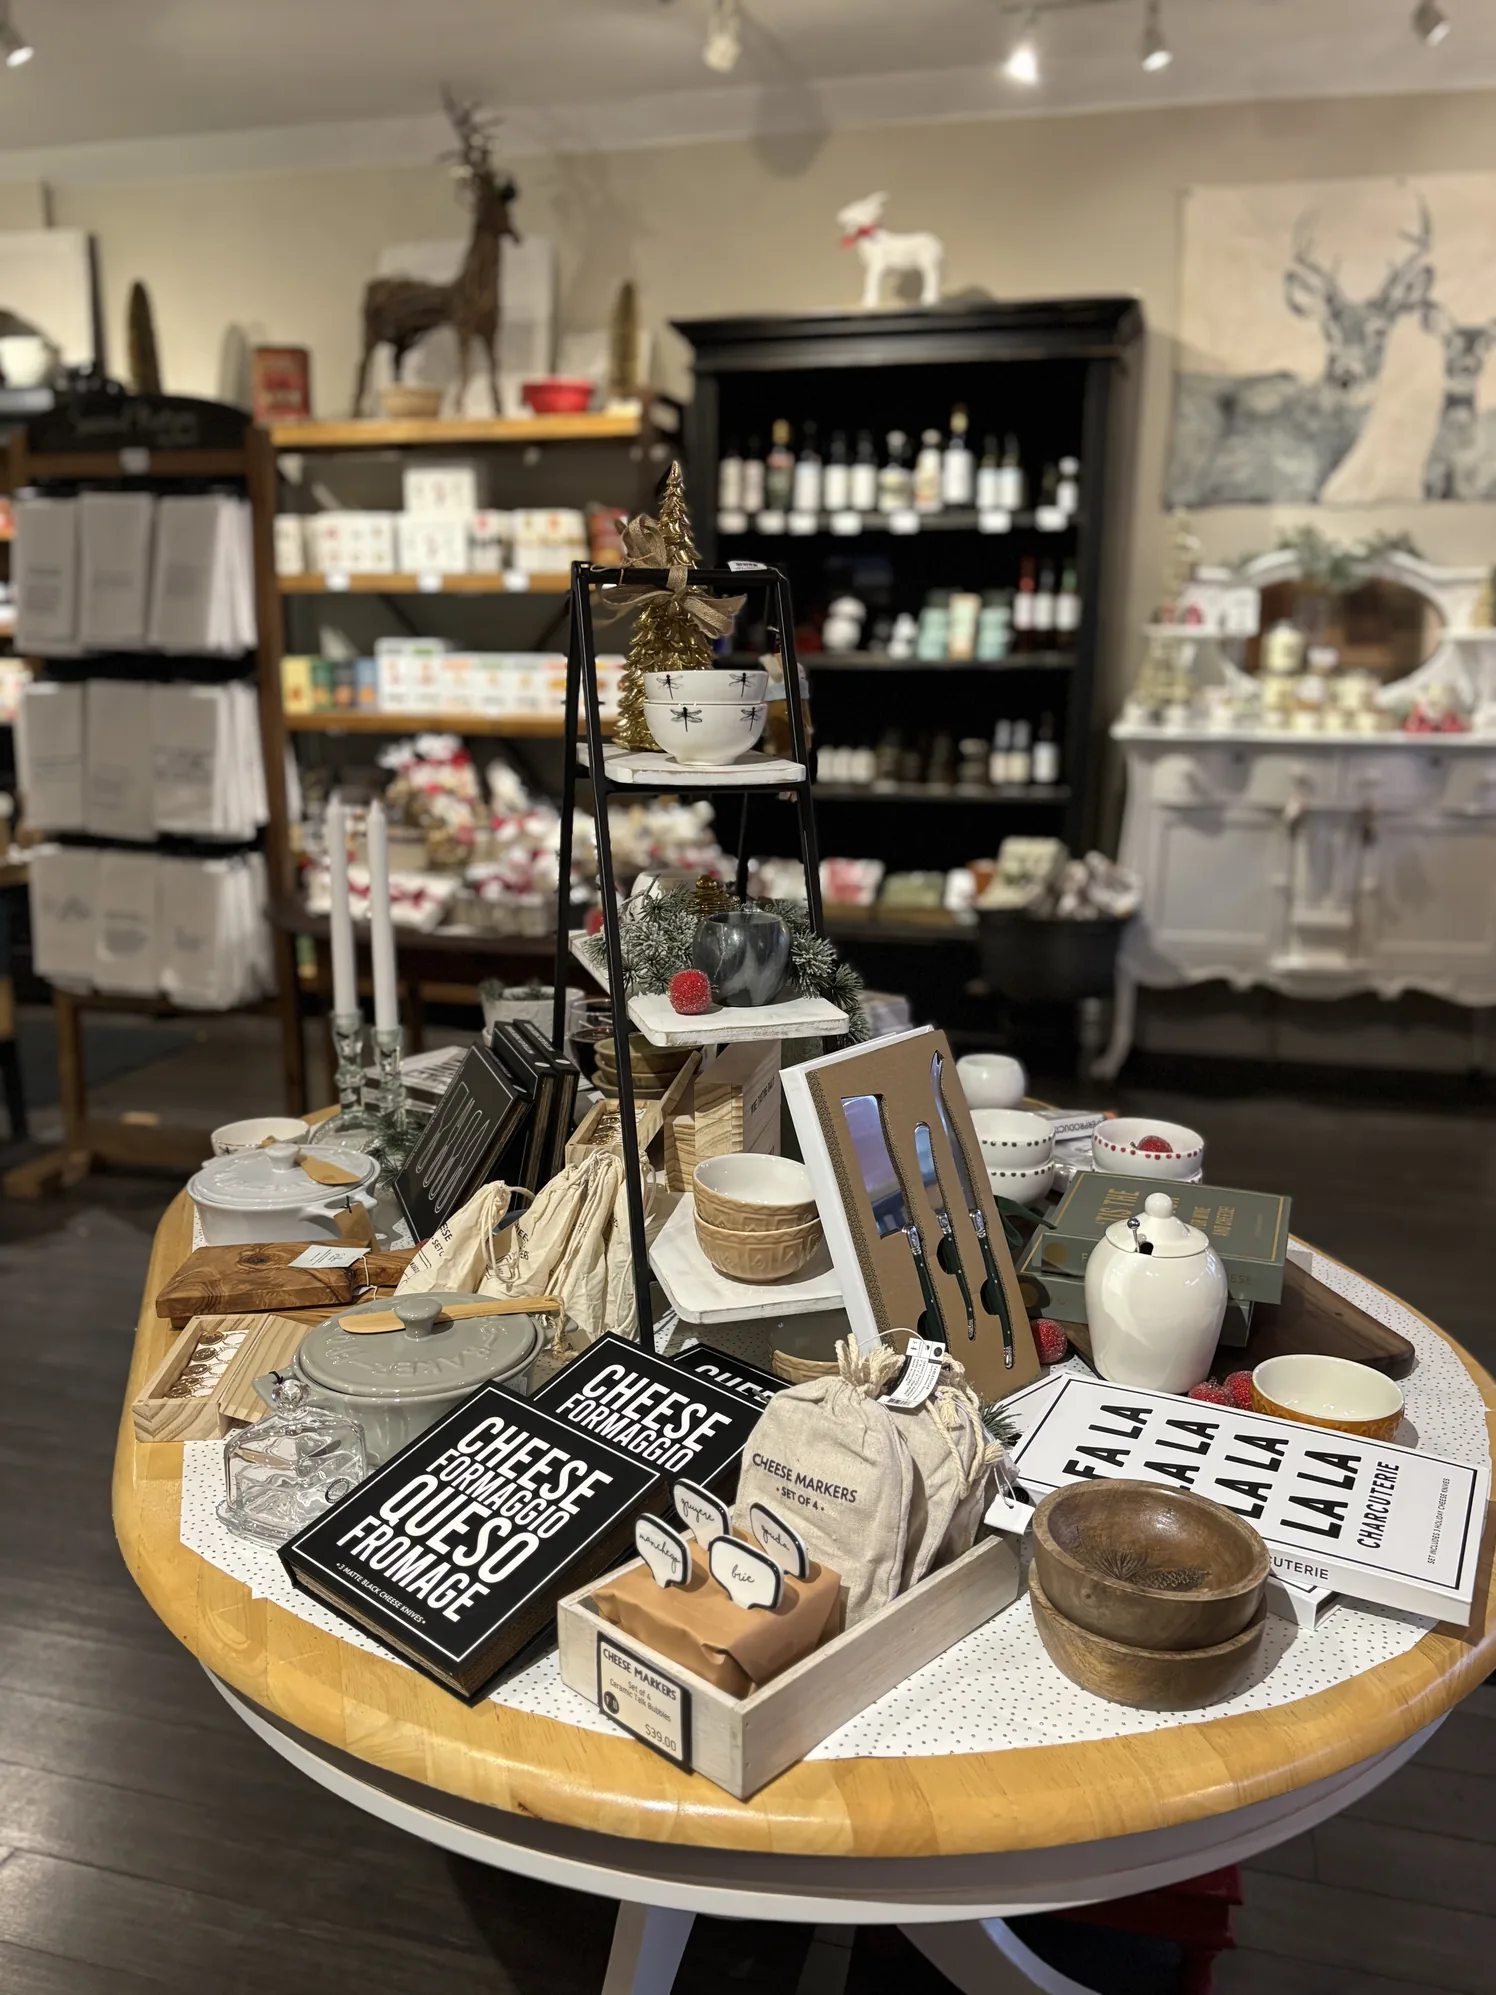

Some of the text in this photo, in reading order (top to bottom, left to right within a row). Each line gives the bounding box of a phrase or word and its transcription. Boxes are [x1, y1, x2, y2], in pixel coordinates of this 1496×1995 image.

[555, 1392, 694, 1473] FORMAGGIO
[582, 1364, 733, 1452] CHEESE
[1088, 1405, 1153, 1439] LA
[457, 1416, 613, 1514] CHEESE
[752, 1453, 858, 1503] CHEESE MARKERS
[1143, 1419, 1220, 1491] A LA
[1224, 1434, 1289, 1472] LA
[426, 1448, 570, 1538] FORMAGGIO
[781, 1486, 819, 1511] SET OF 4
[1280, 1451, 1362, 1539] LA LA
[1356, 1461, 1400, 1549] CHARCUTERIE
[1438, 1493, 1448, 1511] CHEESE
[379, 1474, 539, 1583] QUESO
[336, 1515, 490, 1622] FROMAGE
[343, 1567, 363, 1582] MATTE
[361, 1579, 381, 1595] BLACK
[379, 1591, 402, 1609] CHEESE
[400, 1605, 424, 1623] KNIVES
[731, 1564, 755, 1583] brie
[1269, 1556, 1329, 1580] UTERIE
[603, 1648, 677, 1700] CHEESE MARKERS
[610, 1678, 633, 1698] Ceramic
[647, 1702, 672, 1722] Bubbles
[627, 1681, 640, 1694] Set
